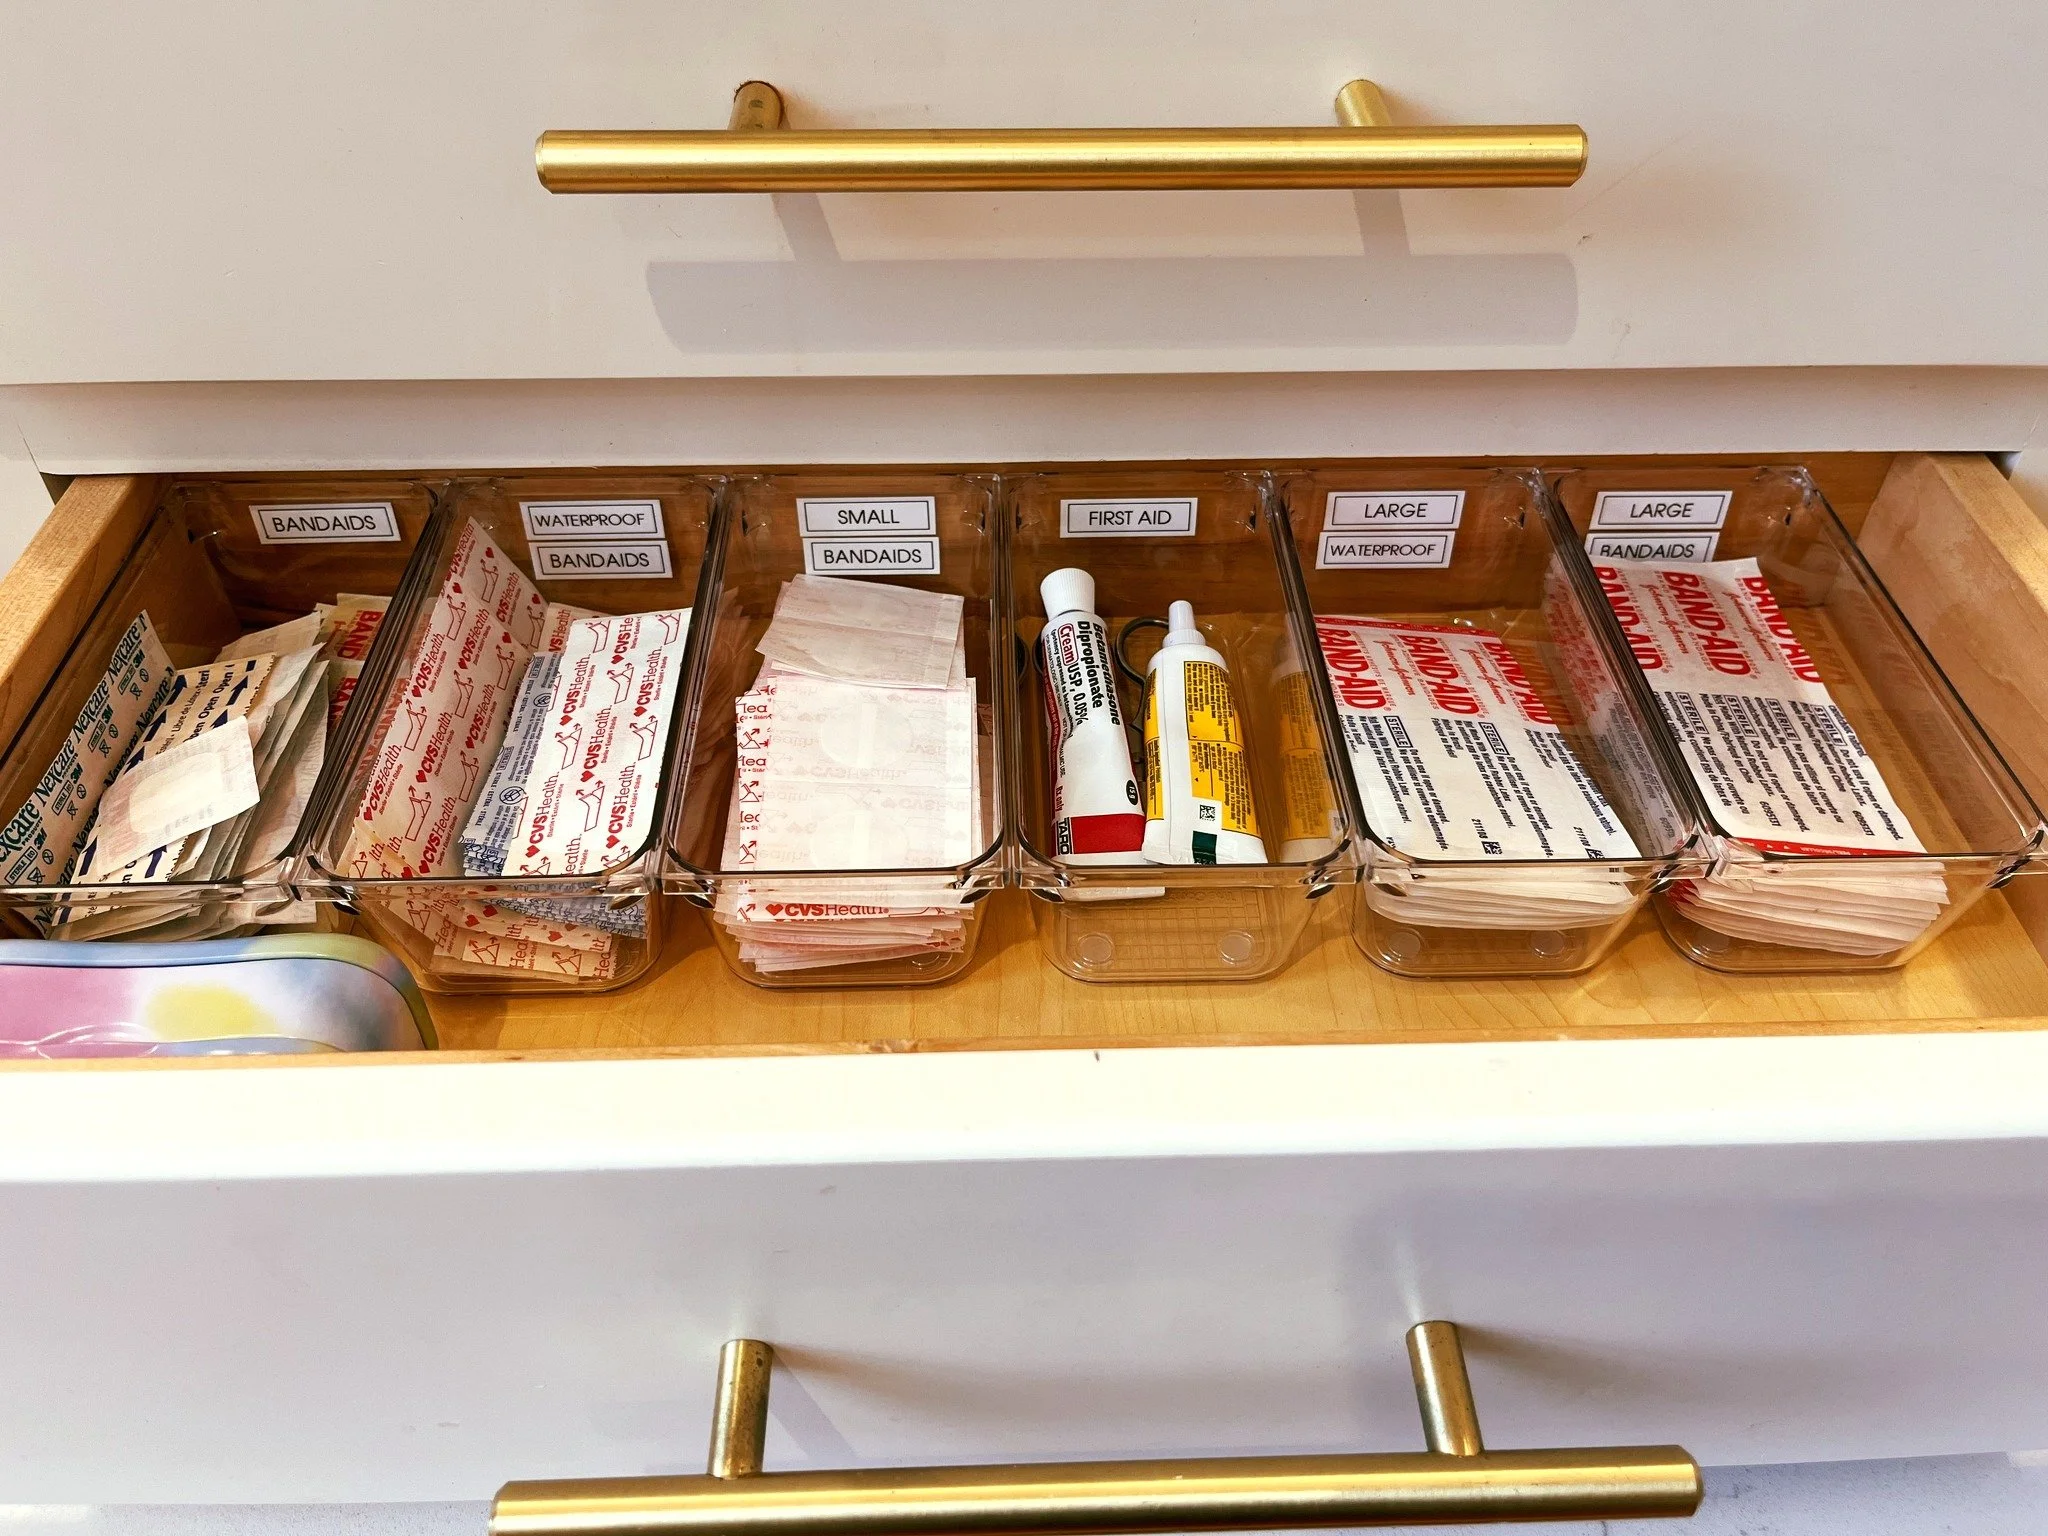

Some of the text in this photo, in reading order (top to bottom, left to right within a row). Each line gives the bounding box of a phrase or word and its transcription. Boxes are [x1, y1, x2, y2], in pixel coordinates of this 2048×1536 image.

[535, 513, 645, 528] WATERPROOF
[837, 508, 900, 525] SMALL
[1089, 510, 1172, 526] FIRST AID
[1364, 502, 1428, 518] LARGE
[1630, 502, 1694, 518] LARGE
[273, 515, 377, 533] BANDAIDS
[550, 552, 650, 569] BANDAIDS
[823, 547, 922, 564] BANDAIDS
[1330, 542, 1436, 557] WATERPROOF
[1600, 543, 1695, 558] BANDAIDS
[549, 609, 571, 652] VSHealth
[1662, 571, 1752, 676] BAND-AID
[1742, 577, 1821, 683] BAND-AID
[132, 649, 146, 669] 3M
[1687, 632, 1714, 671] BANDAGES
[1059, 625, 1075, 663] Cream
[1073, 690, 1090, 726] 0.05%
[1077, 620, 1103, 709] Dipropionate
[1093, 622, 1121, 726] Betamethasone
[1319, 629, 1385, 710] BAND-AID
[1399, 635, 1480, 715] BAND-AID
[198, 672, 234, 719] Open Open
[33, 738, 76, 807] Nexcare
[73, 679, 110, 744] Nexcare
[107, 623, 142, 685] Nexcare
[101, 704, 114, 724] 3M
[1727, 698, 1755, 735] STERILE
[1814, 707, 1843, 744] STERILE
[1483, 725, 1505, 752] STERILE
[1750, 741, 1763, 749] Do
[1755, 750, 1769, 761] not
[1762, 762, 1775, 772] use
[70, 762, 84, 785] 3M
[1770, 779, 1786, 793] open
[1054, 786, 1064, 812] Rx only
[22, 816, 43, 846] PRODUCTS
[1058, 818, 1071, 855] TARO
[10, 827, 48, 881] STERILE 3M
[785, 902, 884, 917] CVSHealth
